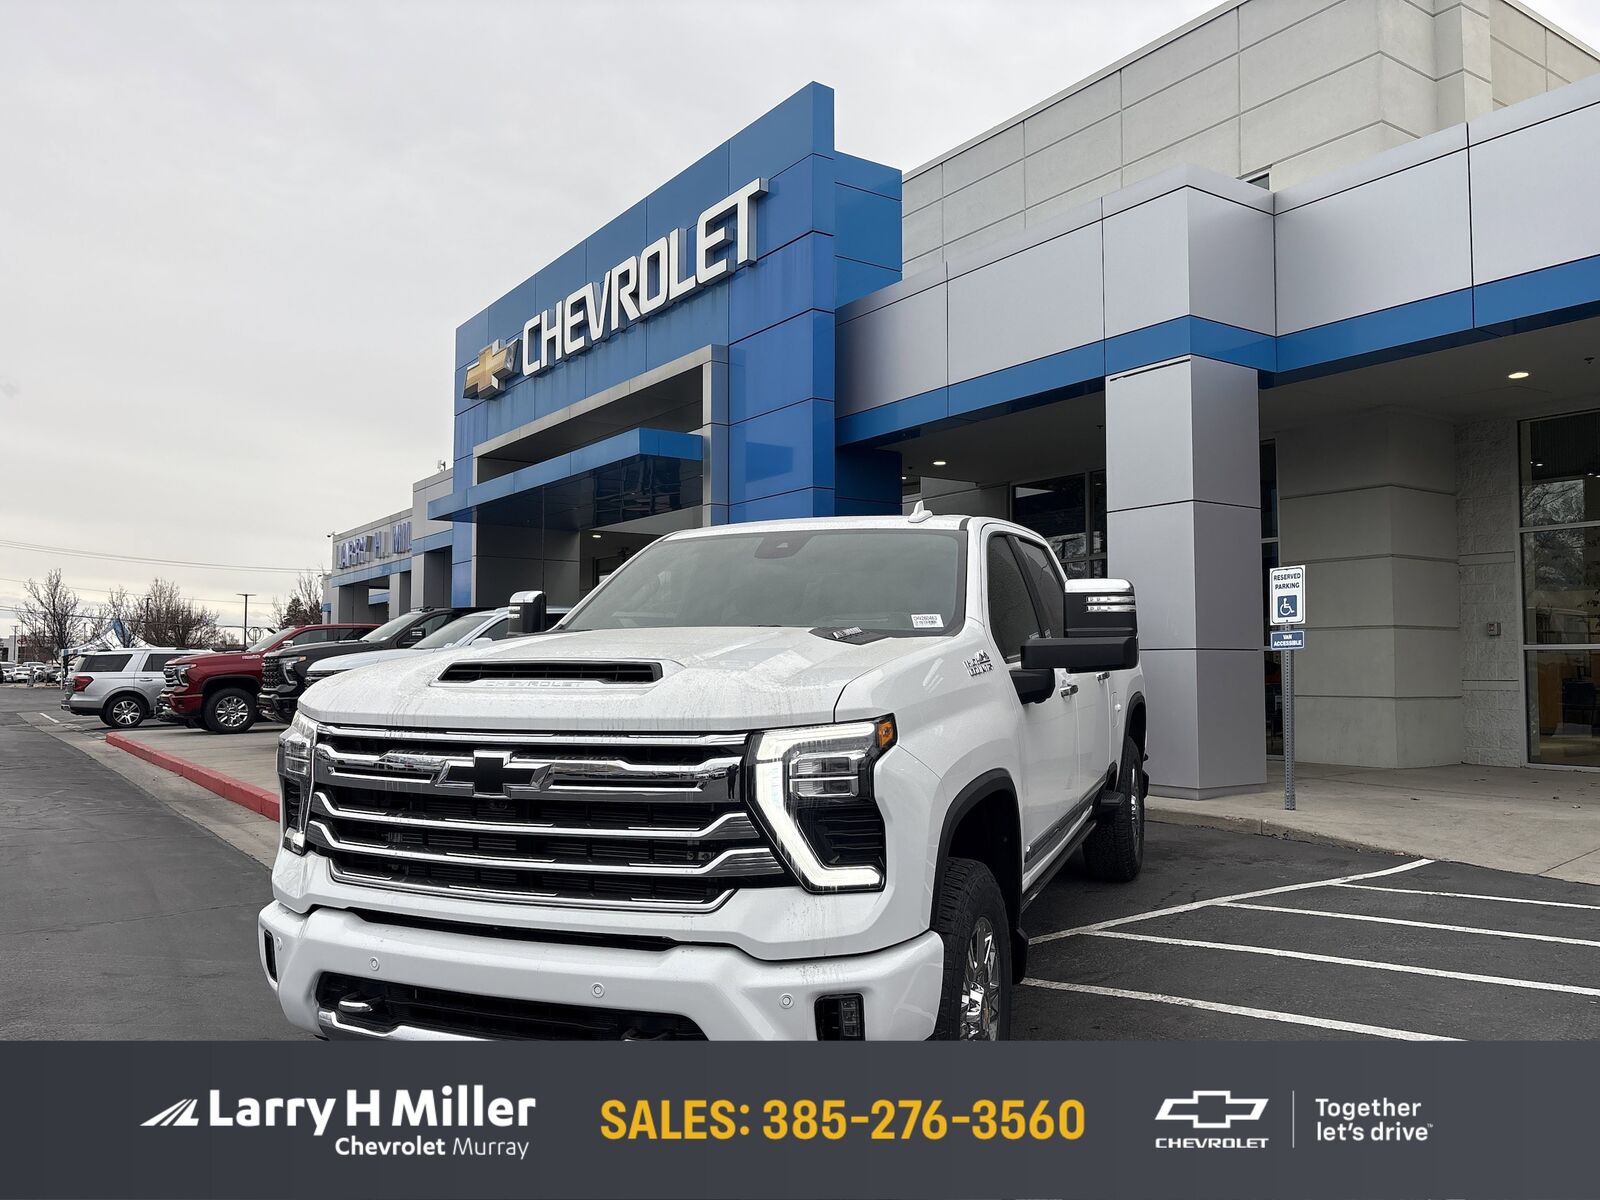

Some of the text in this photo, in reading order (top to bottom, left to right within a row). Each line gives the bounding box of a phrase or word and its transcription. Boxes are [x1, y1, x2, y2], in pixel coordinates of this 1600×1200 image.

[522, 177, 768, 377] CHEVROLET
[1273, 572, 1302, 581] RESERVED
[1274, 582, 1300, 590] PARKING
